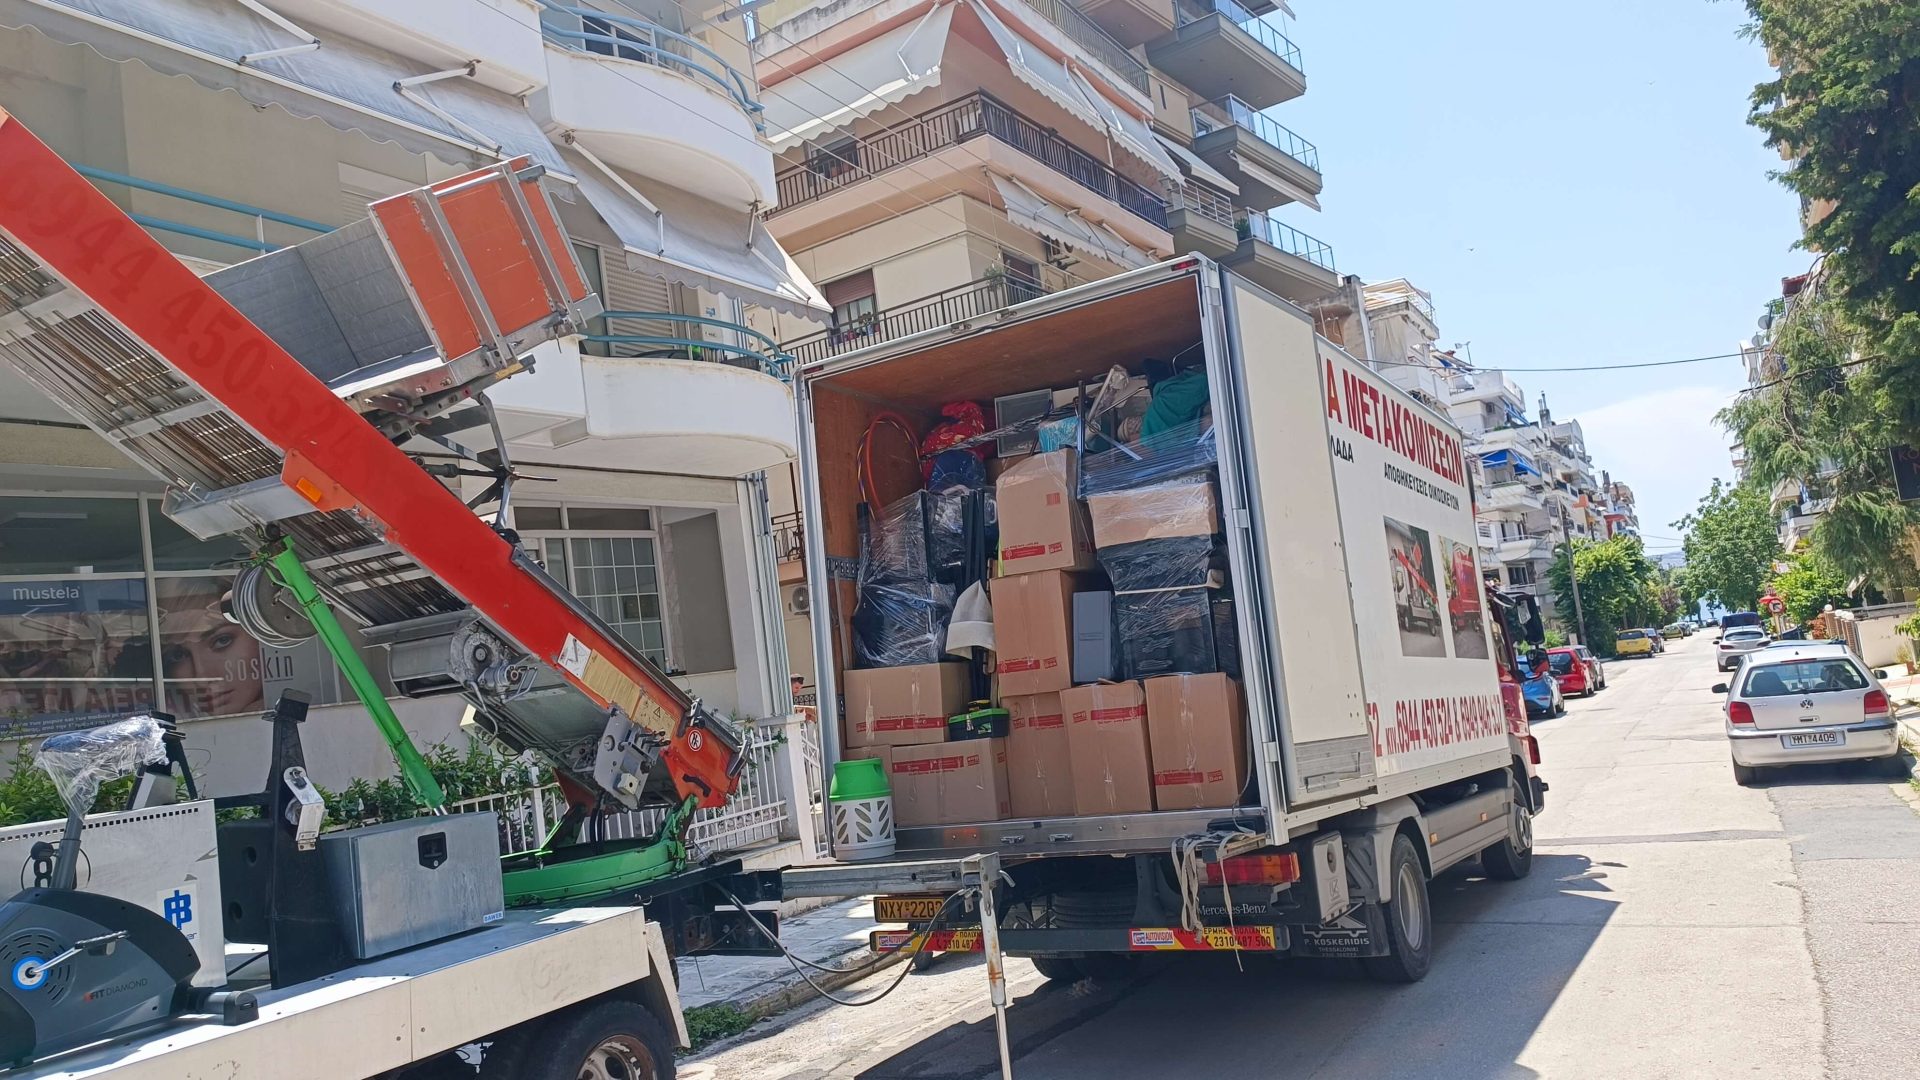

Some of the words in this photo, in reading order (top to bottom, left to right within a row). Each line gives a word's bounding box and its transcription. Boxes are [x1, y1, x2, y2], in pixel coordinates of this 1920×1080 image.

[1343, 369, 1465, 487] ΜΕΤΑΚΟΜΙΣΕΩΝ
[224, 648, 293, 682] soskin
[1198, 903, 1267, 916] Mercees-Benz
[1145, 931, 1173, 941] AUTOVISION
[1199, 927, 1228, 935] ΕΡΜΗΣ
[1214, 936, 1235, 947] 2310
[1256, 936, 1271, 947] 500
[106, 978, 148, 996] DIAMOND
